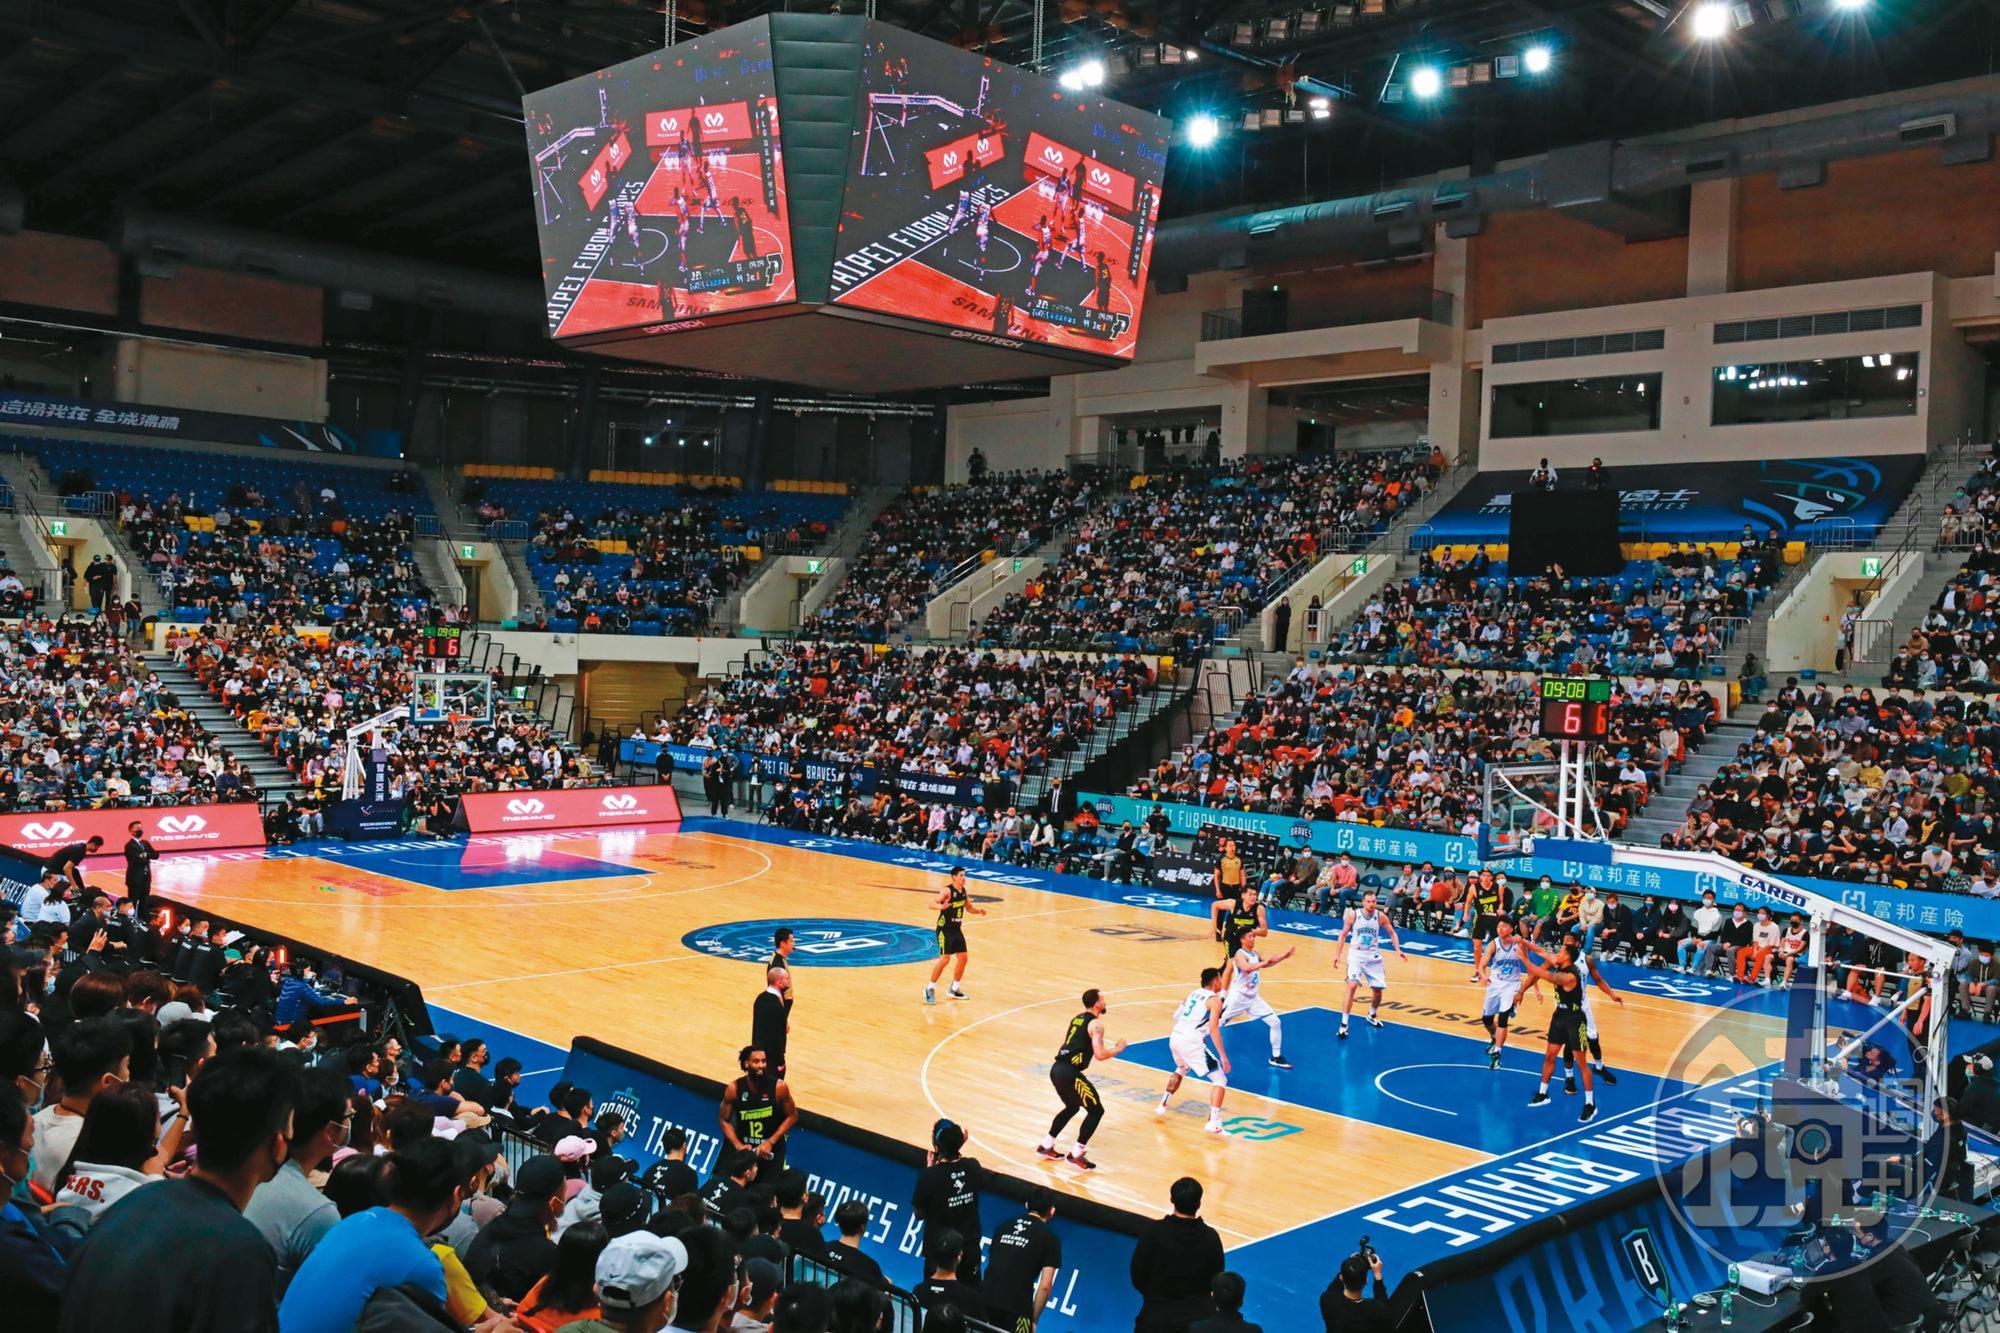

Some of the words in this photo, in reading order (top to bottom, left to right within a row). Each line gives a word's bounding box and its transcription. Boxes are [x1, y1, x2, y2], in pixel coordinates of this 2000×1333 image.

[643, 318, 706, 335] OPTOTECH
[949, 328, 1024, 349] OPTOTECH
[437, 627, 460, 638] 09:08
[429, 640, 436, 655] 6
[448, 639, 457, 656] 6
[1543, 681, 1586, 699] 09:08
[1564, 703, 1581, 734] 6
[1596, 704, 1607, 735] 6
[806, 765, 837, 783] BRAVES
[1290, 827, 1312, 839] BRAVES
[320, 838, 463, 856] FUBON
[1739, 873, 1807, 908] GARED
[1483, 904, 1494, 913] 24
[1183, 999, 1197, 1018] 3
[749, 1121, 763, 1138] 12
[1362, 1151, 1642, 1247] BRAVES
